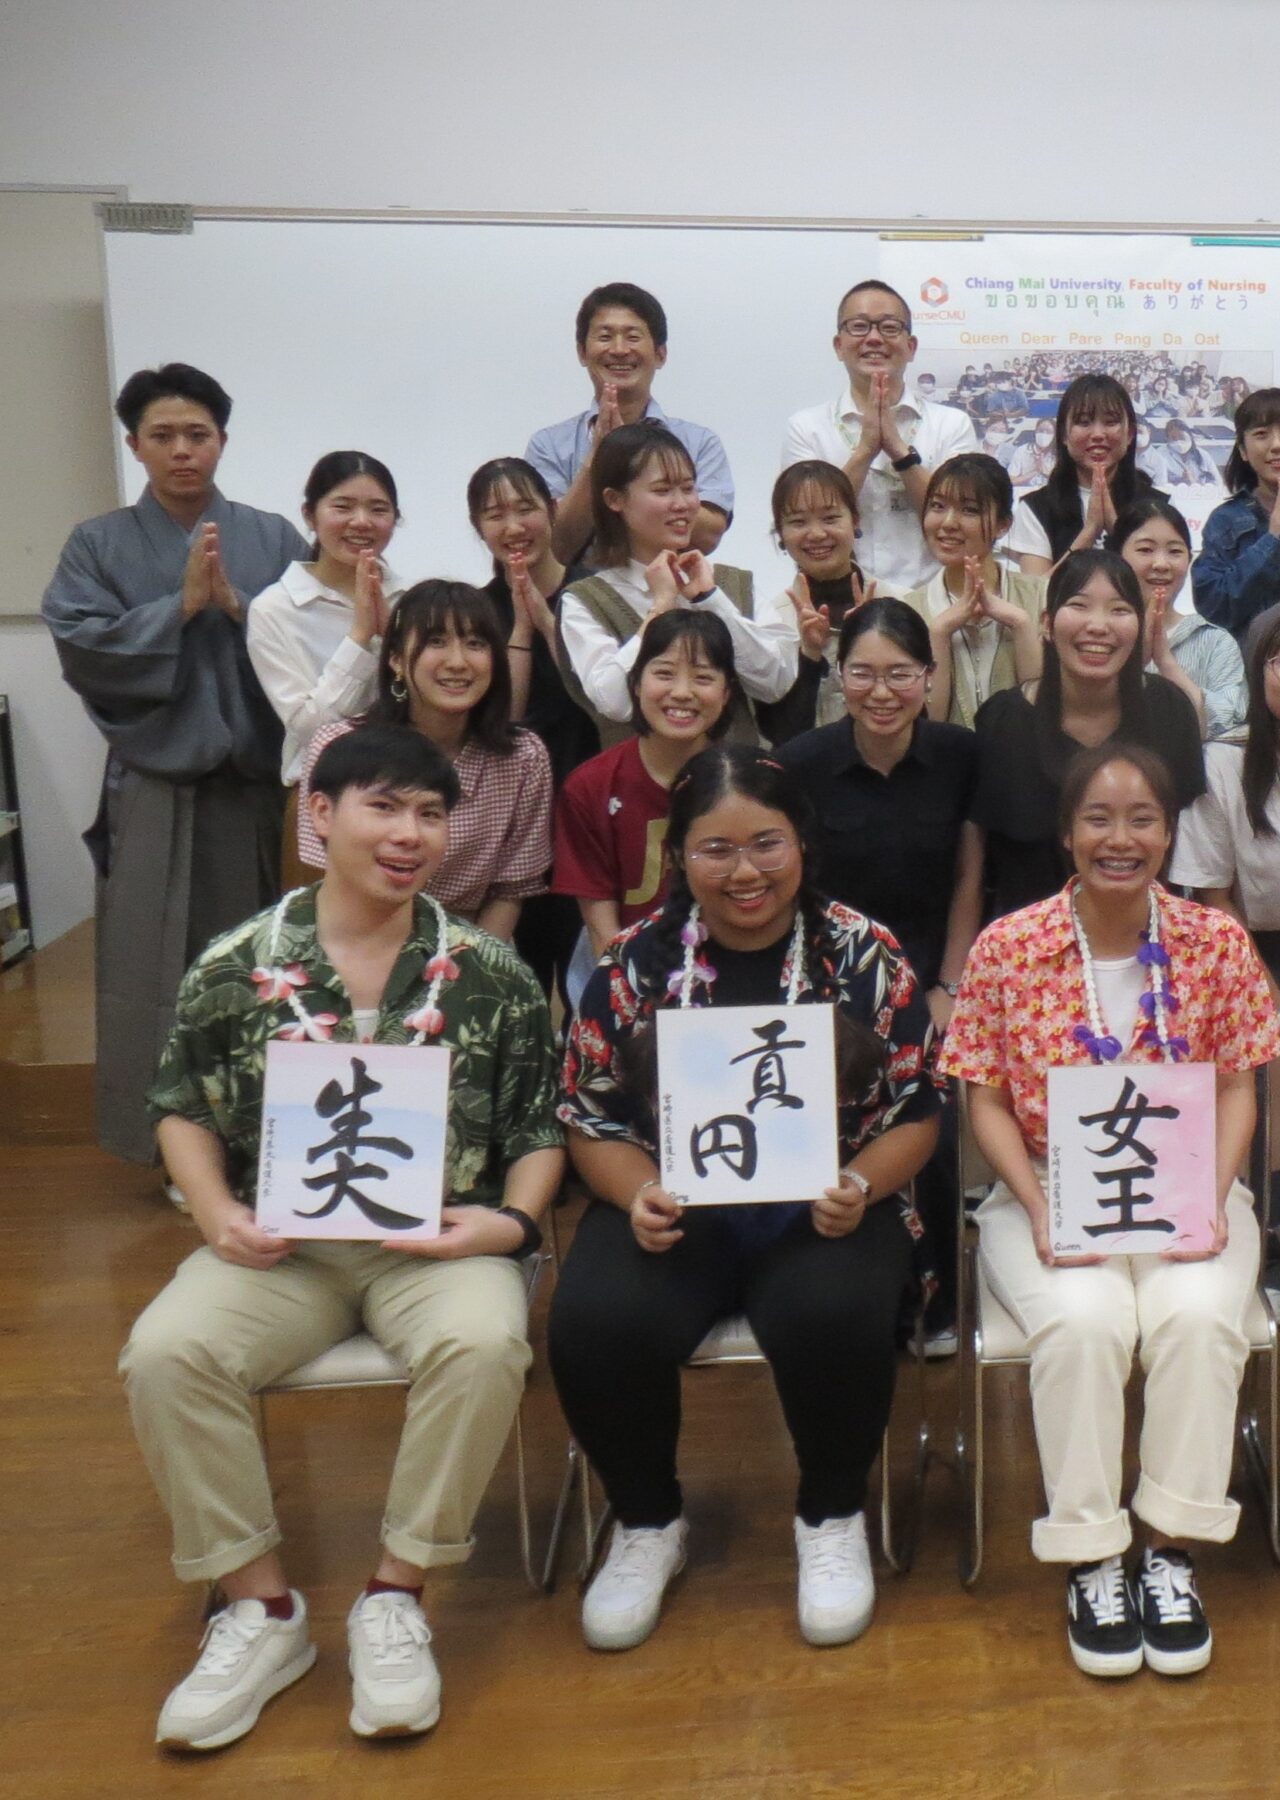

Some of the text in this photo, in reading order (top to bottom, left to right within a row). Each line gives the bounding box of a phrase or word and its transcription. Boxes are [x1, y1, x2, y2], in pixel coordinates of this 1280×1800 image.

[965, 277, 1266, 294] Chiang Mai University Faculty of Nursing
[911, 308, 966, 320] urseCMU
[960, 332, 1220, 347] Queen Dear Pare Pang Da Oat
[1078, 1076, 1181, 1238] 女王
